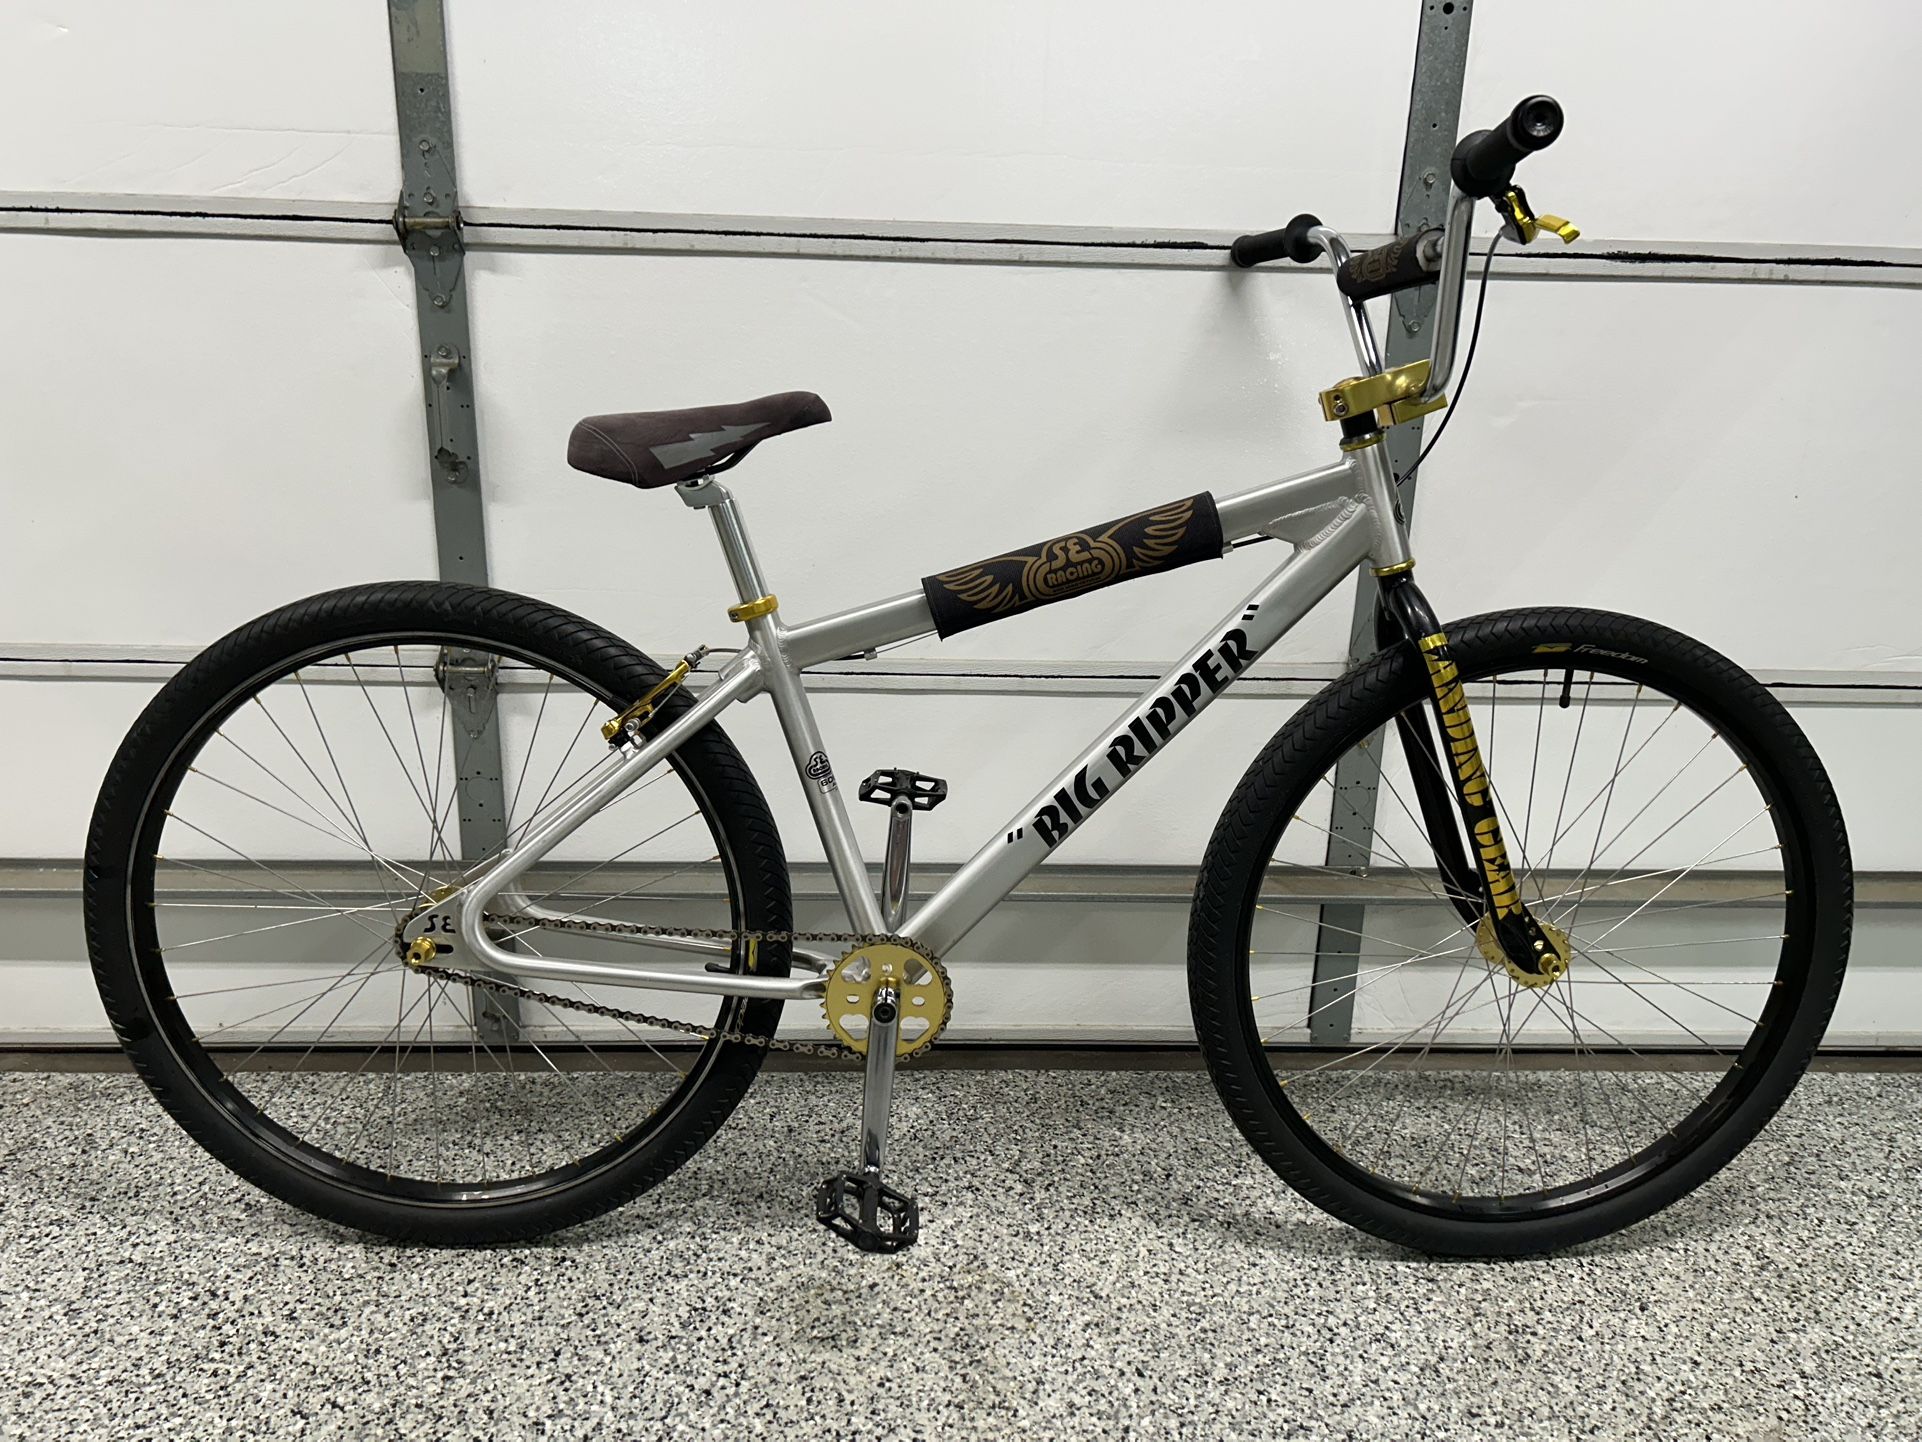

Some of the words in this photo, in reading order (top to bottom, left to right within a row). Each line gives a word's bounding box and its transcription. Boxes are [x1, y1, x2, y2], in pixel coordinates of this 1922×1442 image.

[1049, 537, 1091, 571] SE
[1047, 559, 1103, 587] RACING
[1574, 643, 1649, 664] Freedom
[1419, 633, 1490, 807] LANDING
[1474, 816, 1523, 921] GEAR
[423, 914, 457, 934] SE
